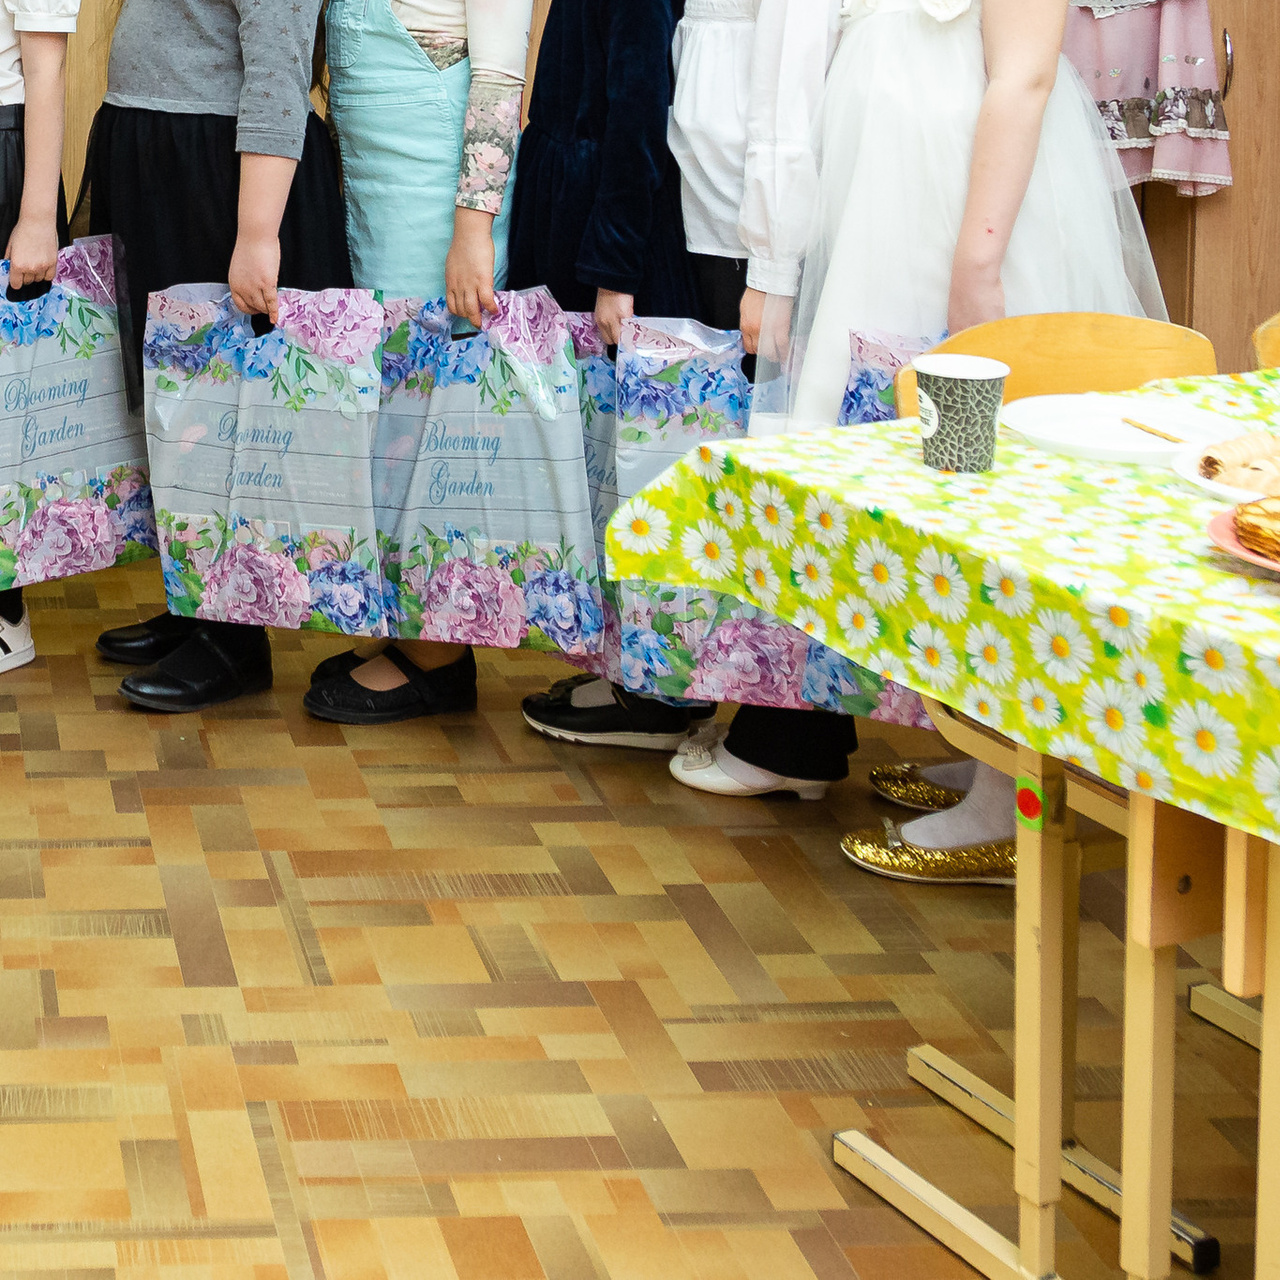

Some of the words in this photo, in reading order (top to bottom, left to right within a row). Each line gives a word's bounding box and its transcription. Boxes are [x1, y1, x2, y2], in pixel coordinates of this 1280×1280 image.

[21, 415, 86, 459] Garden
[419, 419, 502, 466] Blooming
[429, 460, 495, 505] Garden
